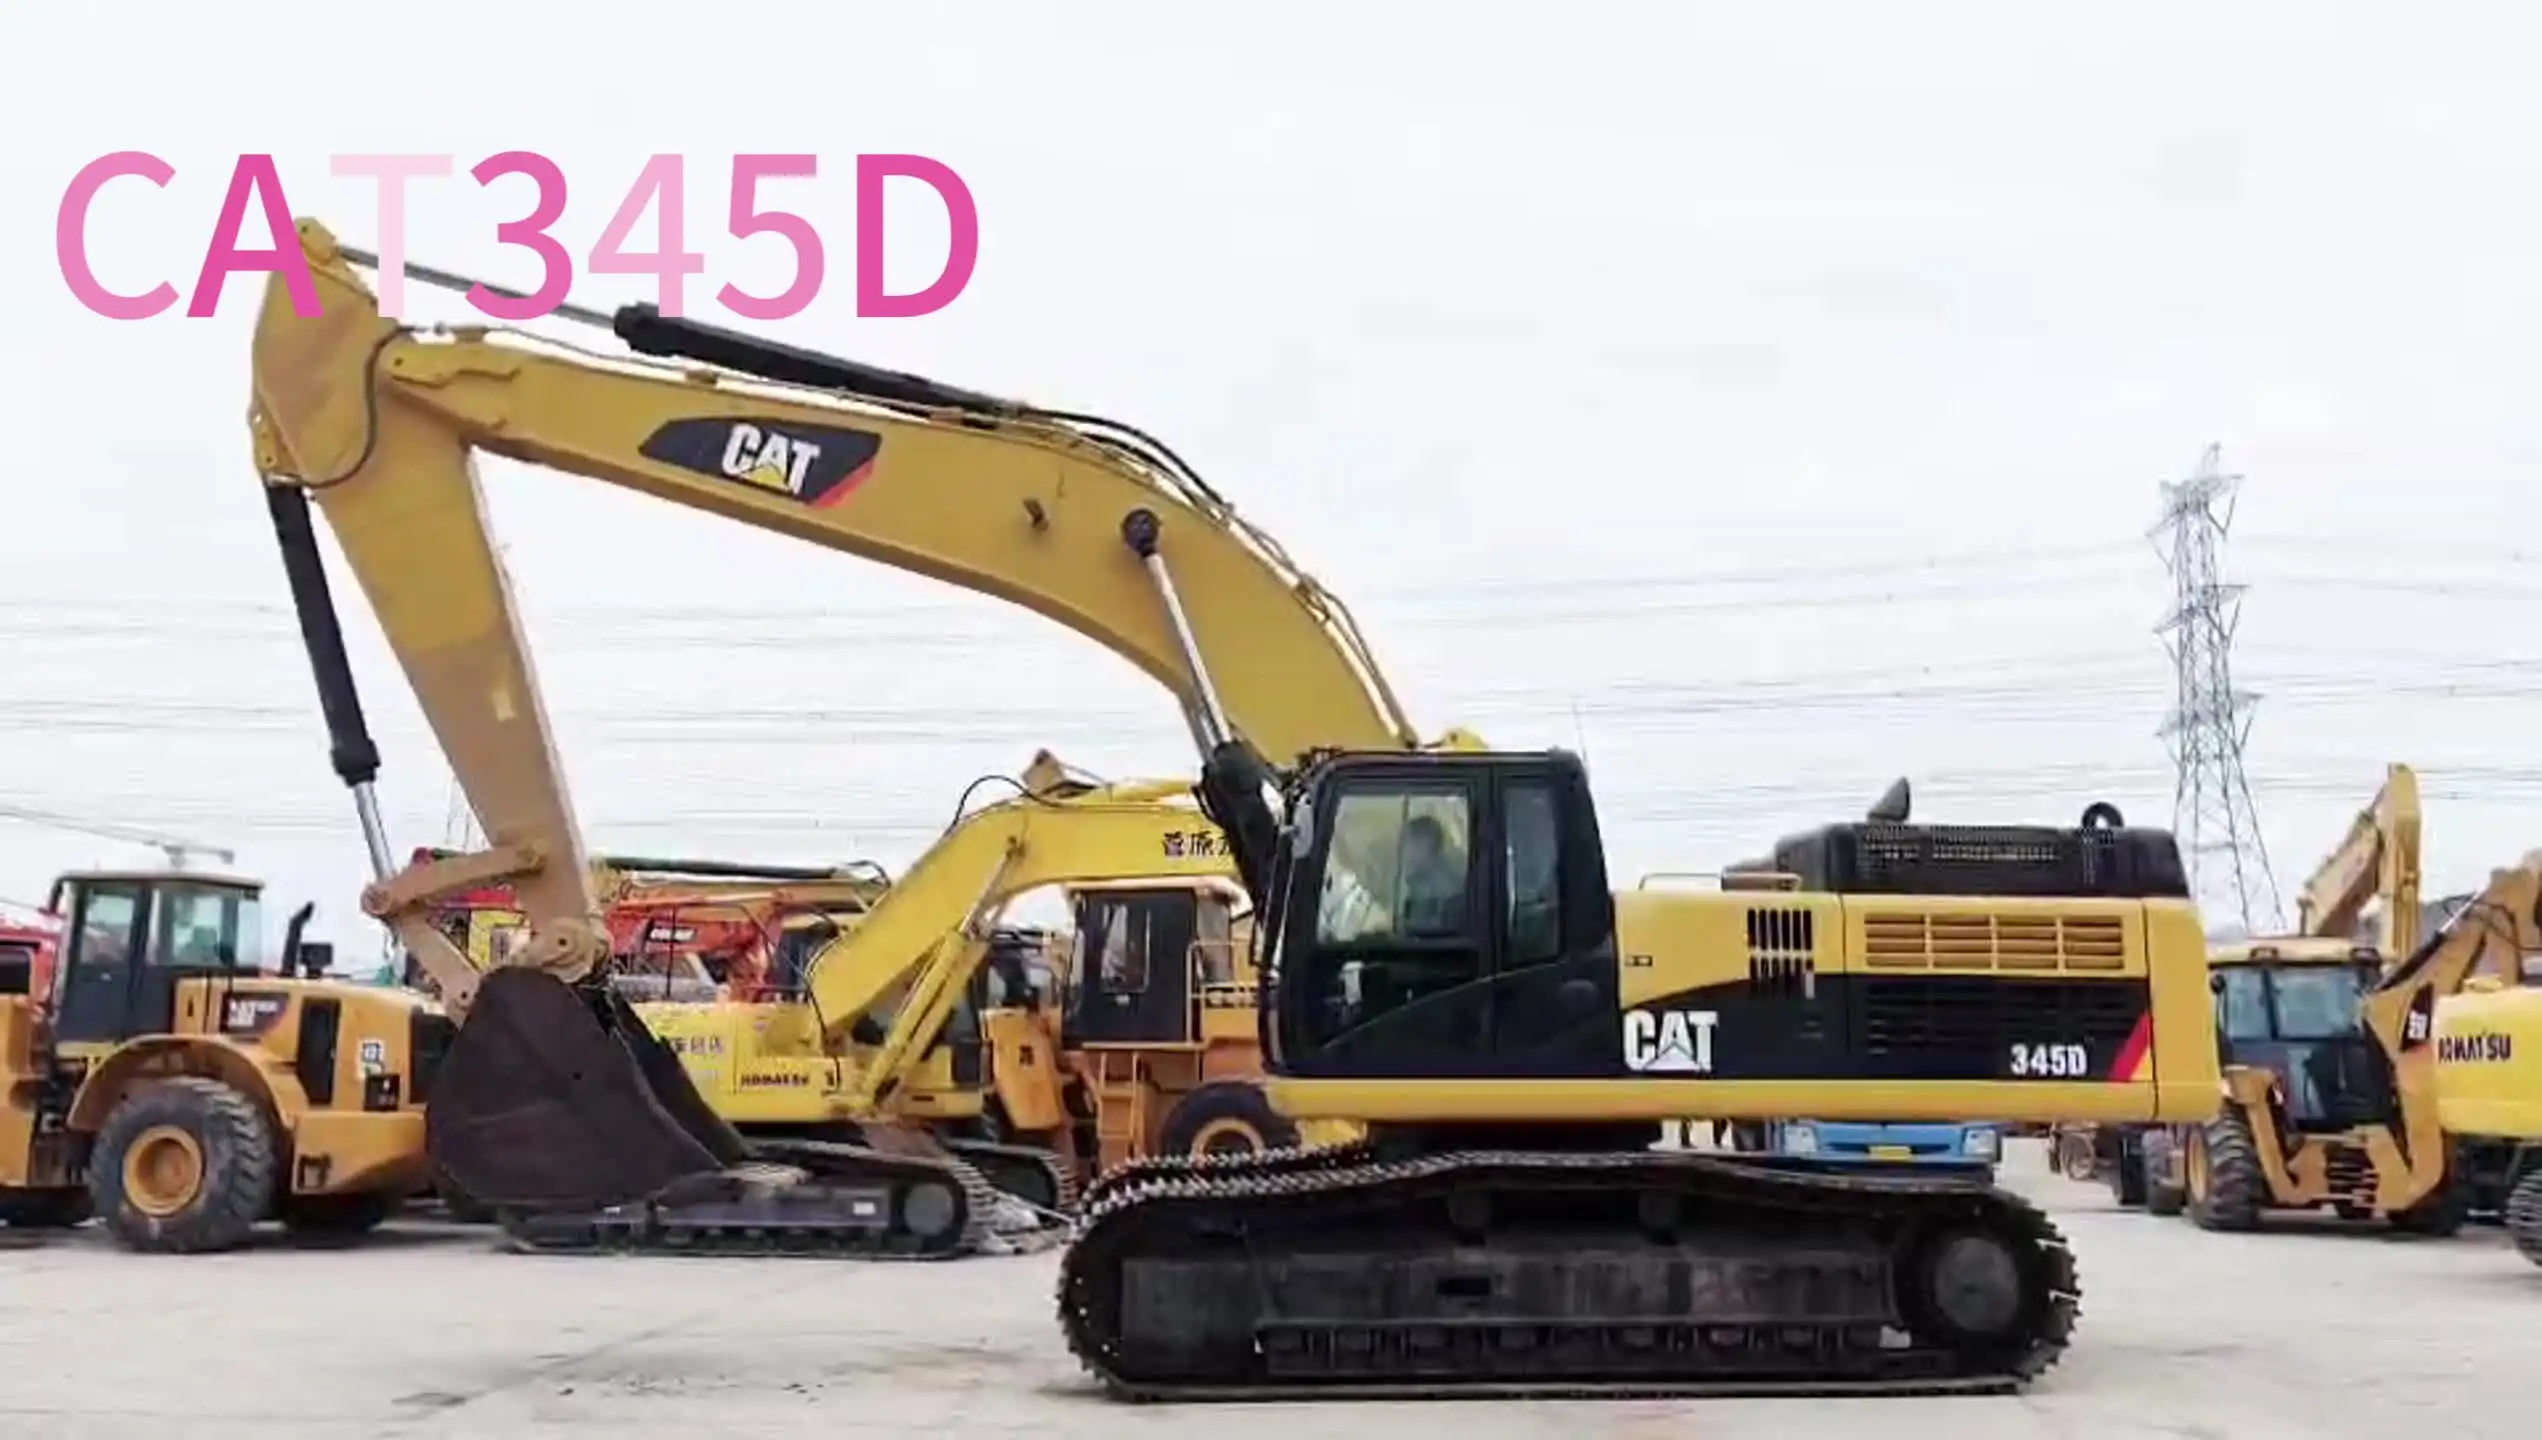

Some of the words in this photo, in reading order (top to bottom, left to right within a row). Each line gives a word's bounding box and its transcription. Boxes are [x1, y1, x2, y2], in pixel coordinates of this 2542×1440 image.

[721, 423, 821, 494] CAT
[1623, 1009, 1718, 1072] CAT
[2010, 1043, 2088, 1076] 345D
